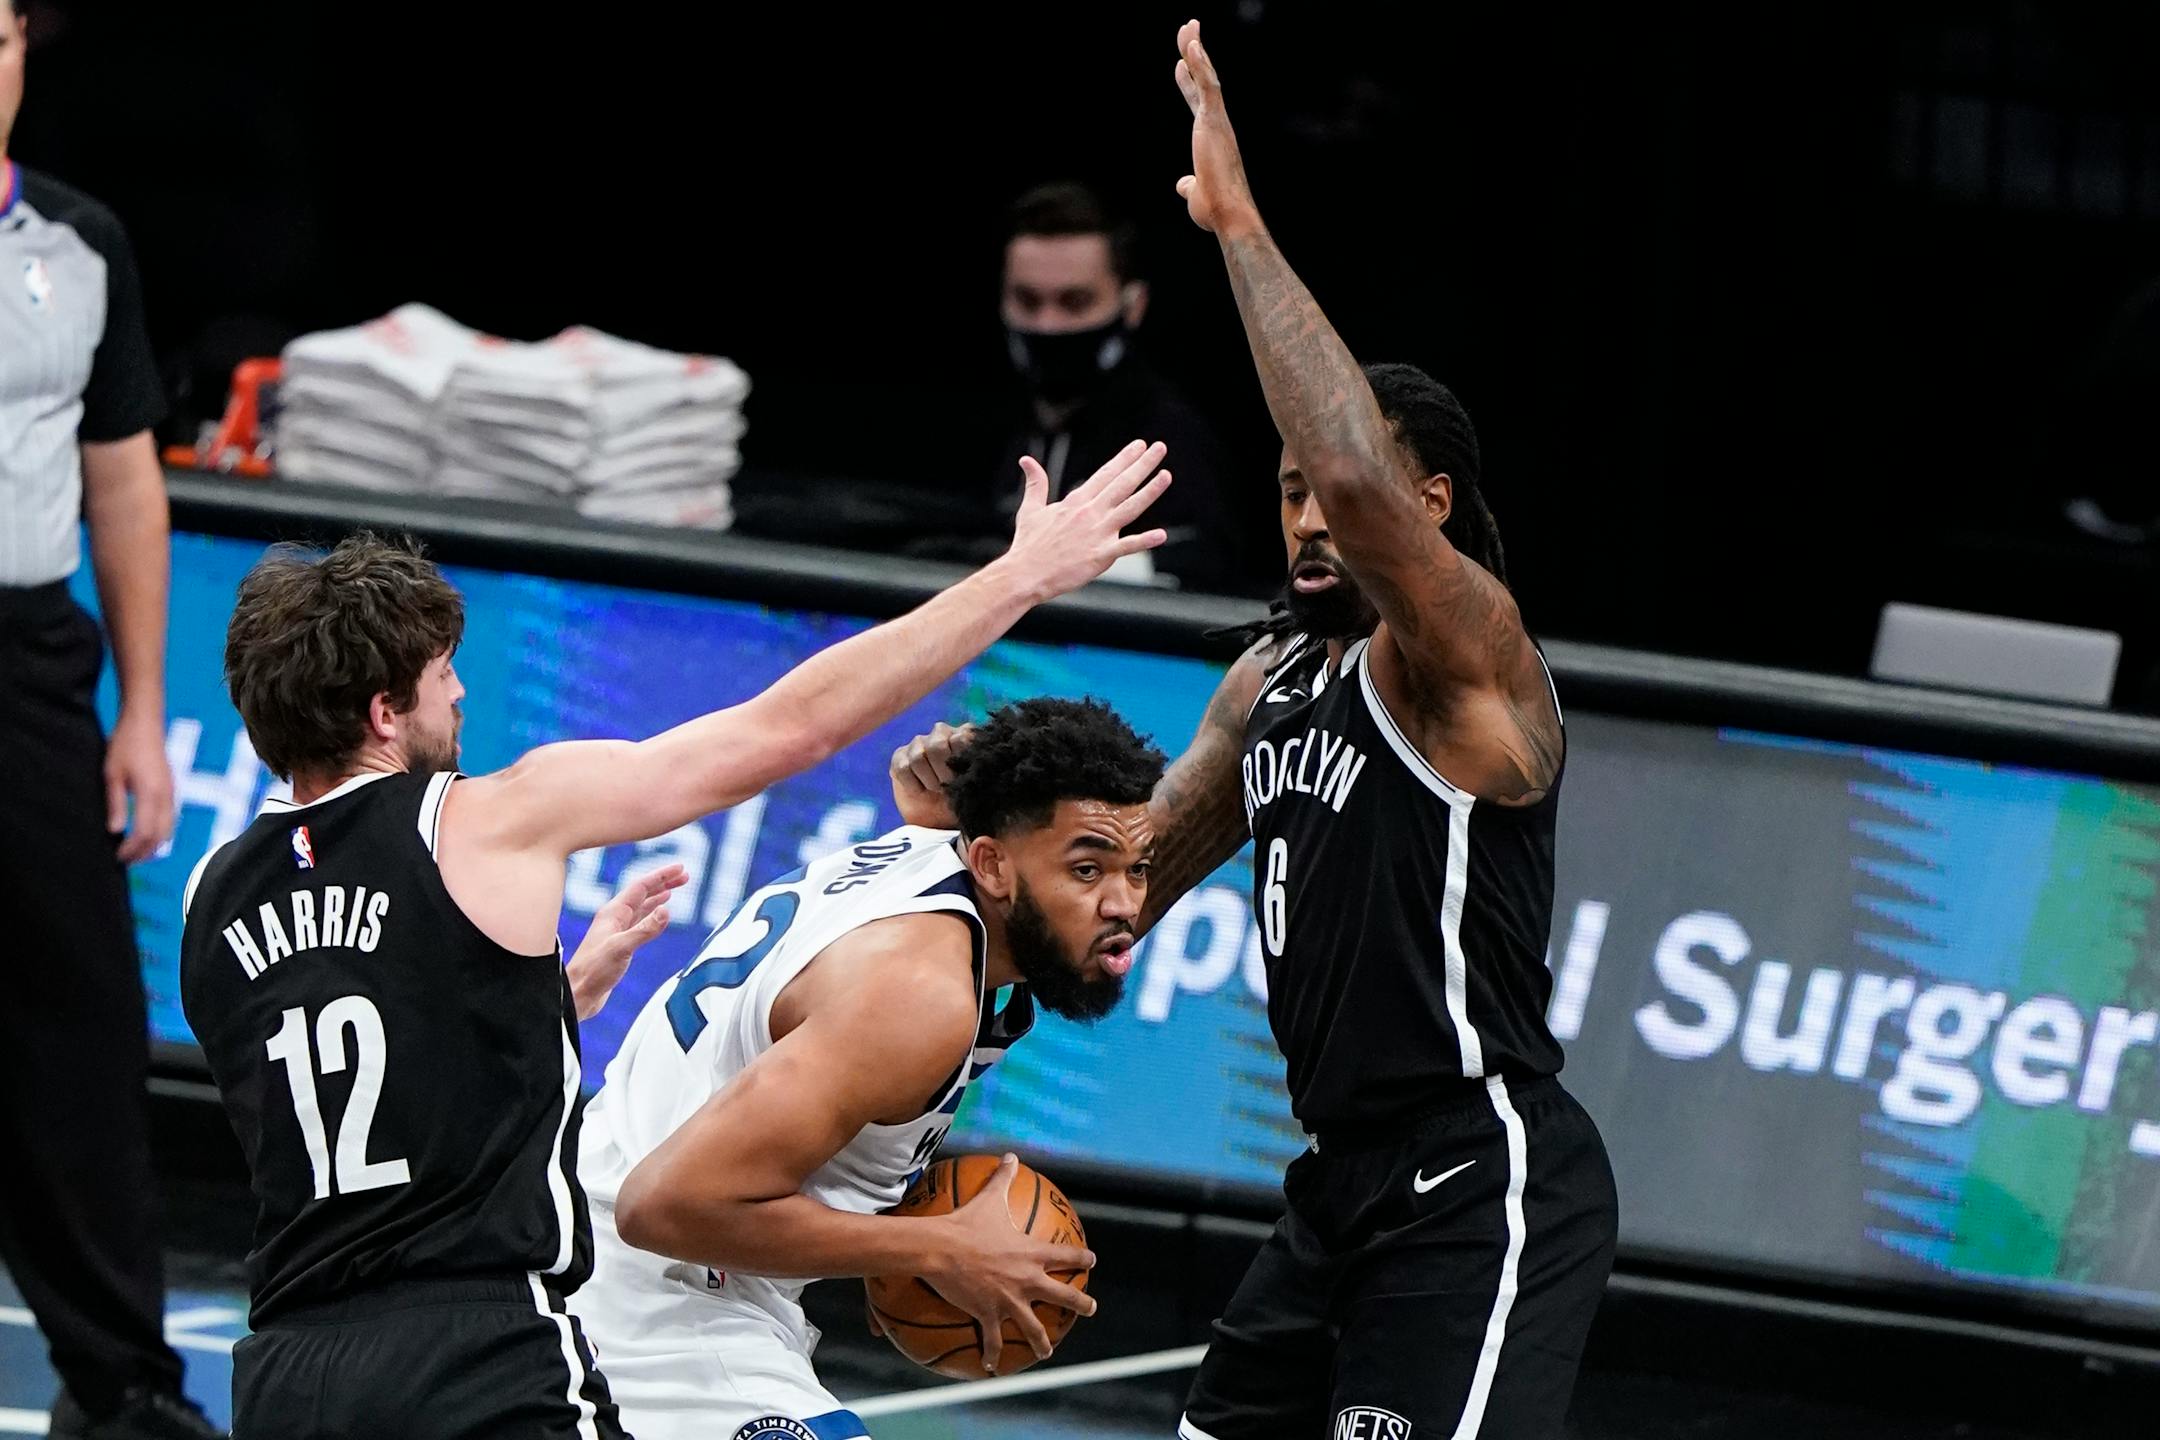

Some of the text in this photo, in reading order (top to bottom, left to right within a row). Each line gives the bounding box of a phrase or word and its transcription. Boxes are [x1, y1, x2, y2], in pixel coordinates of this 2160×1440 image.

[222, 886, 390, 981] HARRIS
[1264, 837, 1288, 957] 6
[1633, 909, 2160, 1156] Surger
[265, 995, 411, 1200] 12
[1337, 1410, 1404, 1440] NETS
